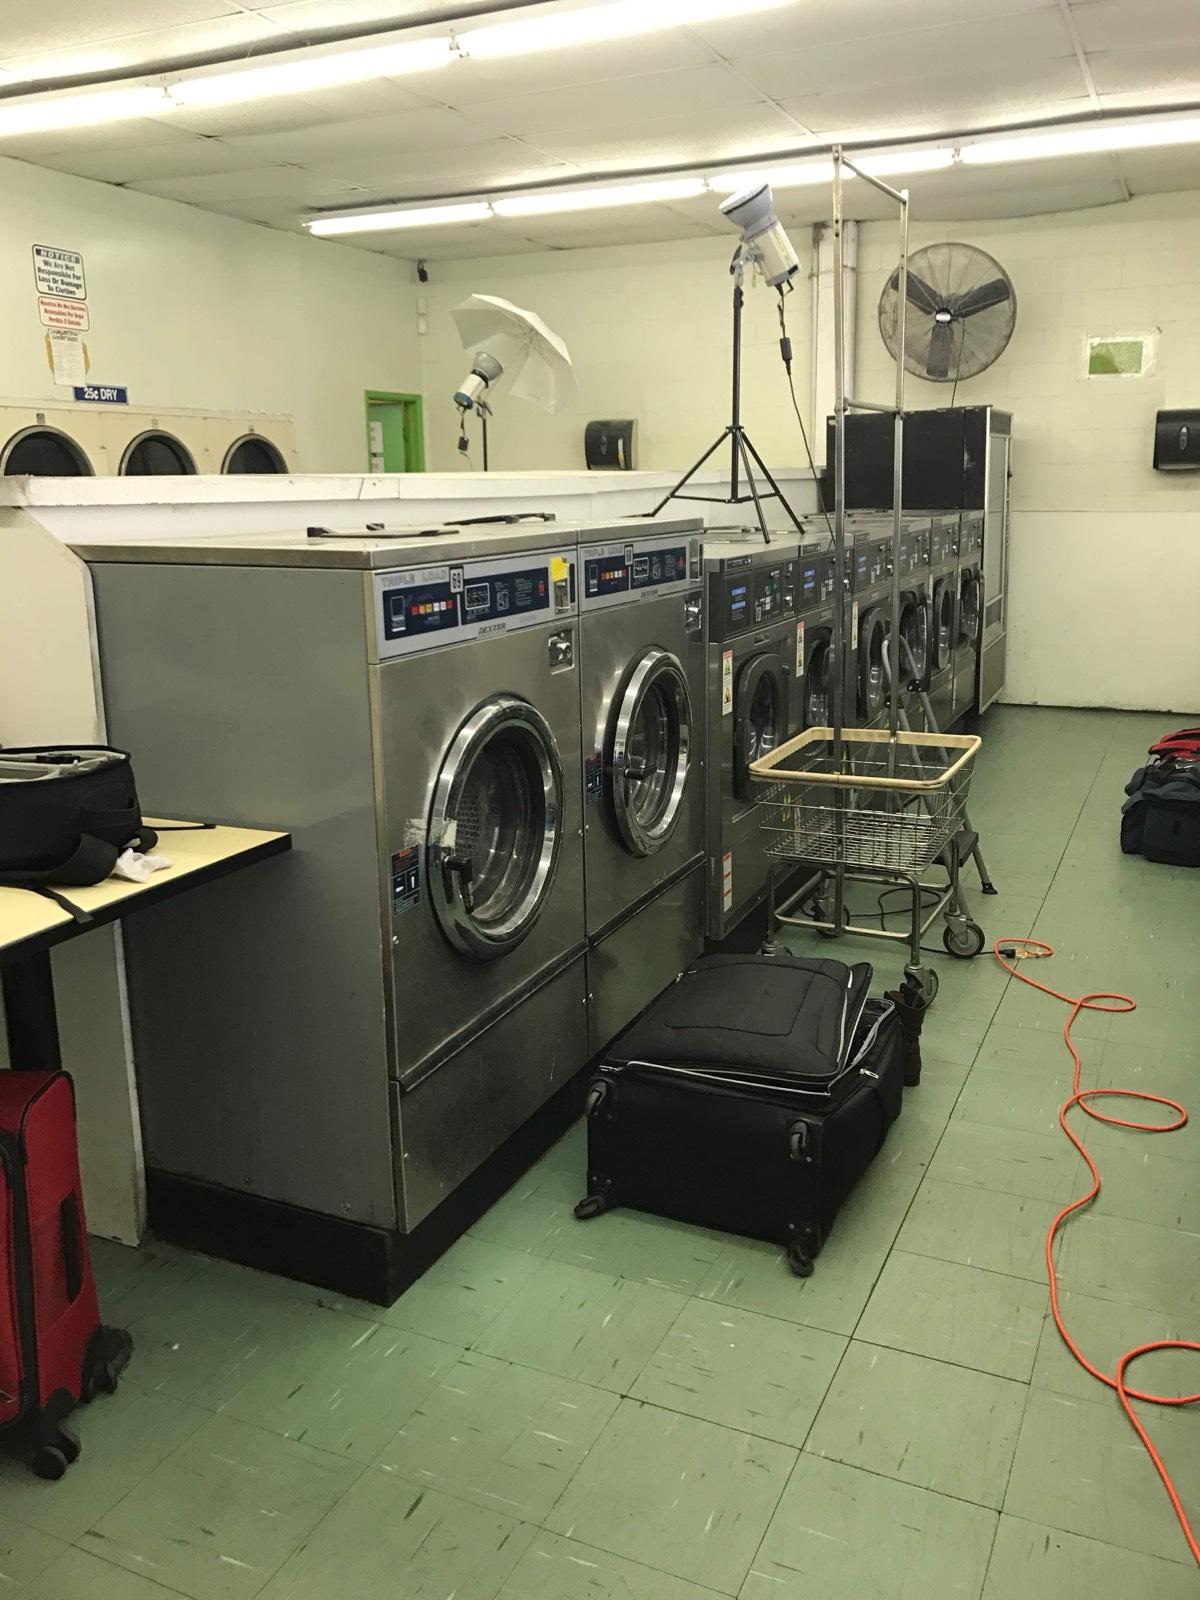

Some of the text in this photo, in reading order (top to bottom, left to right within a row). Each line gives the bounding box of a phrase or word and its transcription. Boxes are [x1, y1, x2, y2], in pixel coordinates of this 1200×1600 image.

[41, 250, 76, 263] NOTICE
[43, 259, 52, 267] We
[37, 266, 81, 281] Responsible For
[38, 275, 51, 283] Loss
[61, 279, 82, 290] Damage
[55, 286, 77, 296] Clothes
[83, 388, 118, 401] 25¢ DRY
[381, 568, 448, 589] TRIPLE LOAD
[478, 622, 507, 636] DEXTER
